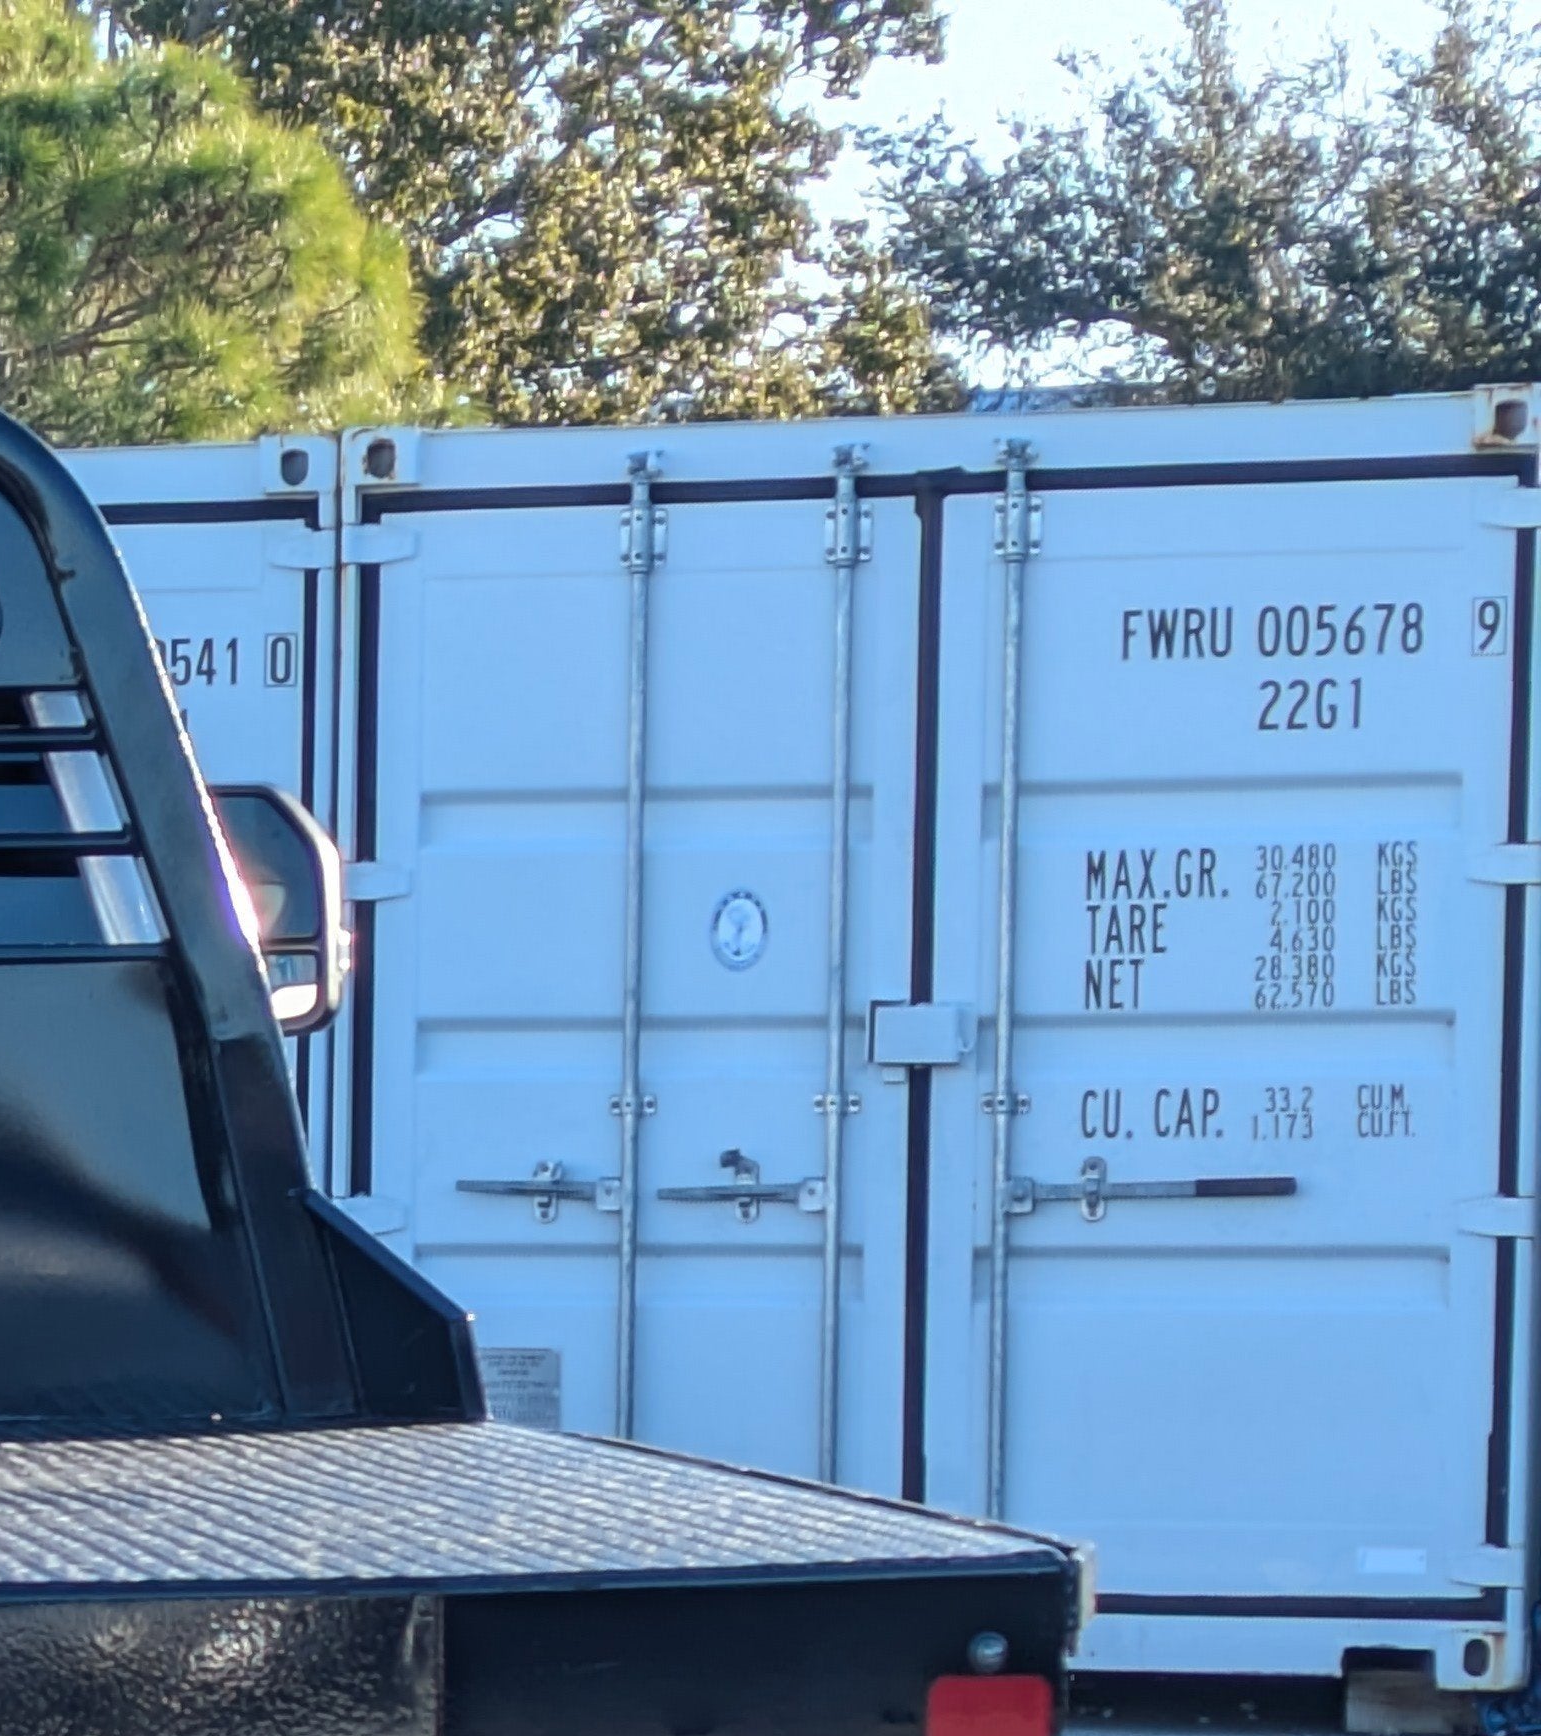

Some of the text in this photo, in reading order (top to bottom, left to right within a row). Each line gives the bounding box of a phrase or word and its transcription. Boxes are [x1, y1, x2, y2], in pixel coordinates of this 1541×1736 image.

[1121, 600, 1501, 660] FWRU 005678 9
[1257, 677, 1363, 731] 22G1
[1085, 840, 1417, 900] MAX.GR. 30.480 KGS
[1254, 867, 1417, 899] 67.200 LBS
[1085, 896, 1417, 955] TARE 2.100 KGS
[1269, 922, 1417, 952] 4.630 LBS
[1084, 950, 1417, 1010] NET 28.380 KGS
[1253, 977, 1416, 1010] 62.570 LBS
[1080, 1089, 1134, 1139] CU.
[1153, 1087, 1224, 1139] CAP.
[1264, 1086, 1314, 1113] 33.2
[1252, 1112, 1314, 1140] 1.173
